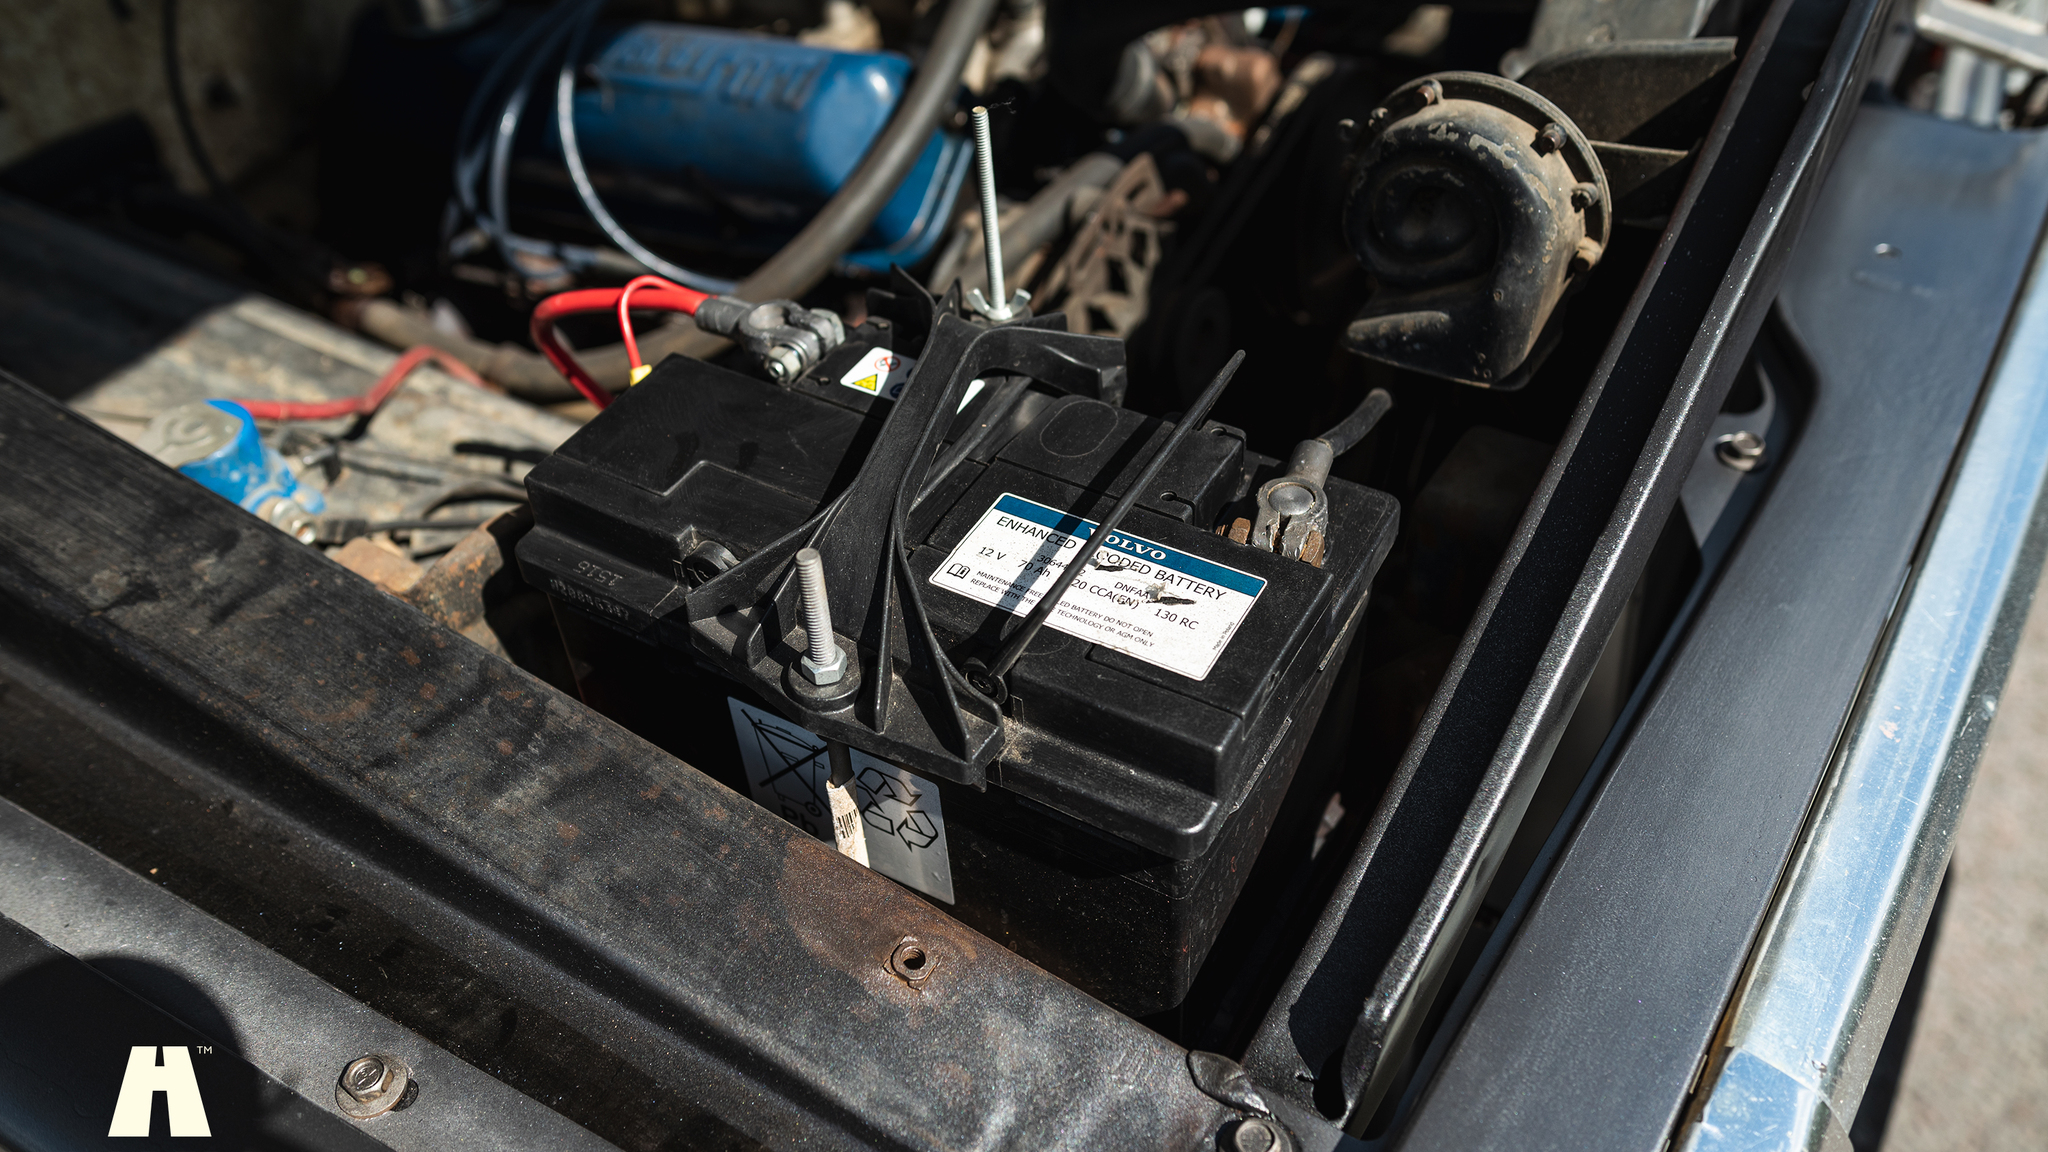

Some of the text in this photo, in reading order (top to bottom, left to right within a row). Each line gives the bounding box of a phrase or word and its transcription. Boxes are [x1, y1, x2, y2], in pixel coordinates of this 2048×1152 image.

[979, 546, 995, 558] 12
[997, 551, 1007, 561] V
[1017, 559, 1034, 571] 70
[1033, 565, 1051, 578] Ah
[1154, 608, 1178, 623] 130
[1179, 617, 1199, 630] RC
[996, 516, 1077, 549] ENHANCED
[1154, 569, 1227, 600] BATTERY
[970, 578, 1000, 593] REPLACE
[1001, 588, 1020, 600] WITH
[1020, 595, 1037, 606] THE
[1057, 608, 1103, 630] TECHNOLOGY
[1104, 624, 1116, 634] OR
[1116, 630, 1134, 641] AGM
[1134, 635, 1155, 648] ONLY
[976, 570, 1026, 591] MAINTENANCE
[1025, 587, 1044, 599] FREE
[1071, 604, 1104, 620] BATTERY
[1103, 615, 1116, 624] DO
[1116, 619, 1134, 630] NOT
[1133, 626, 1154, 638] OPEN
